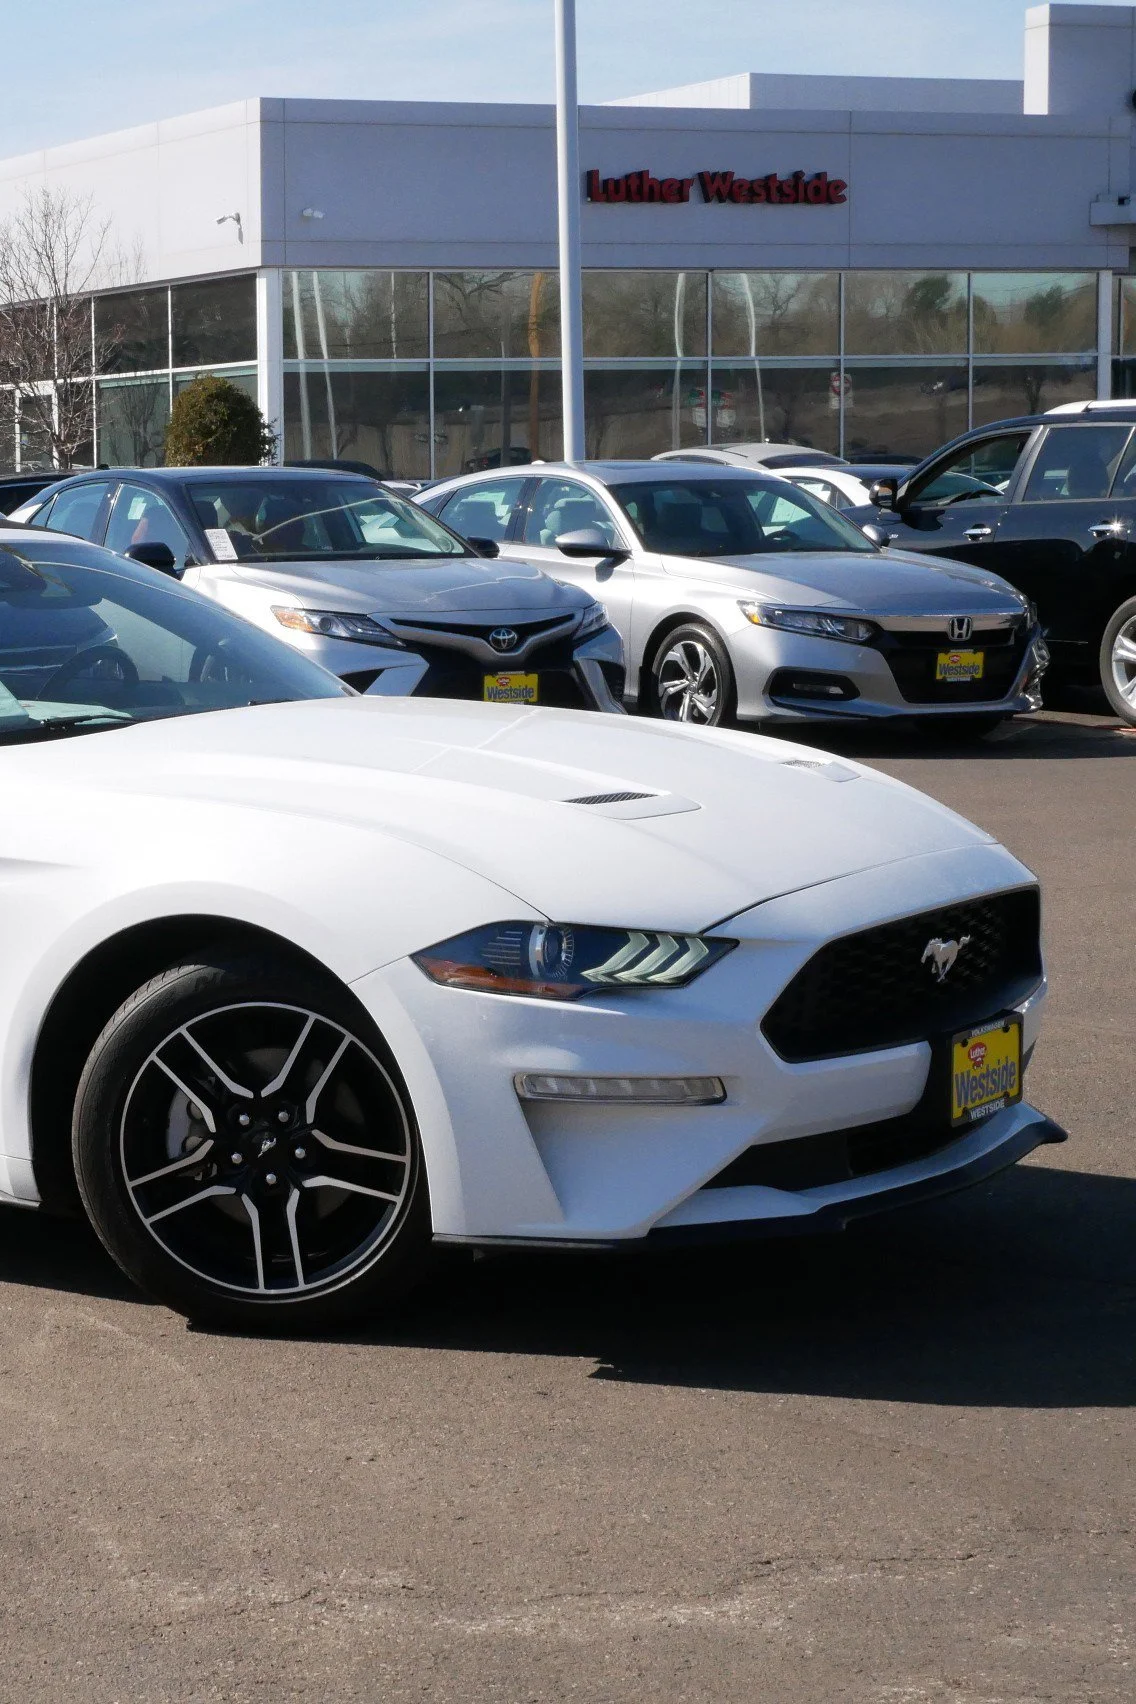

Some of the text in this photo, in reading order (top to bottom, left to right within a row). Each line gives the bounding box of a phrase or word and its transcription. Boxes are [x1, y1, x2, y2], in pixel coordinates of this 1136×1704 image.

[587, 169, 848, 204] Luther Westside
[487, 685, 534, 699] Westside
[970, 1046, 986, 1059] Luther
[955, 1056, 1016, 1107] Westside
[970, 1099, 1005, 1119] WESTSIDE
